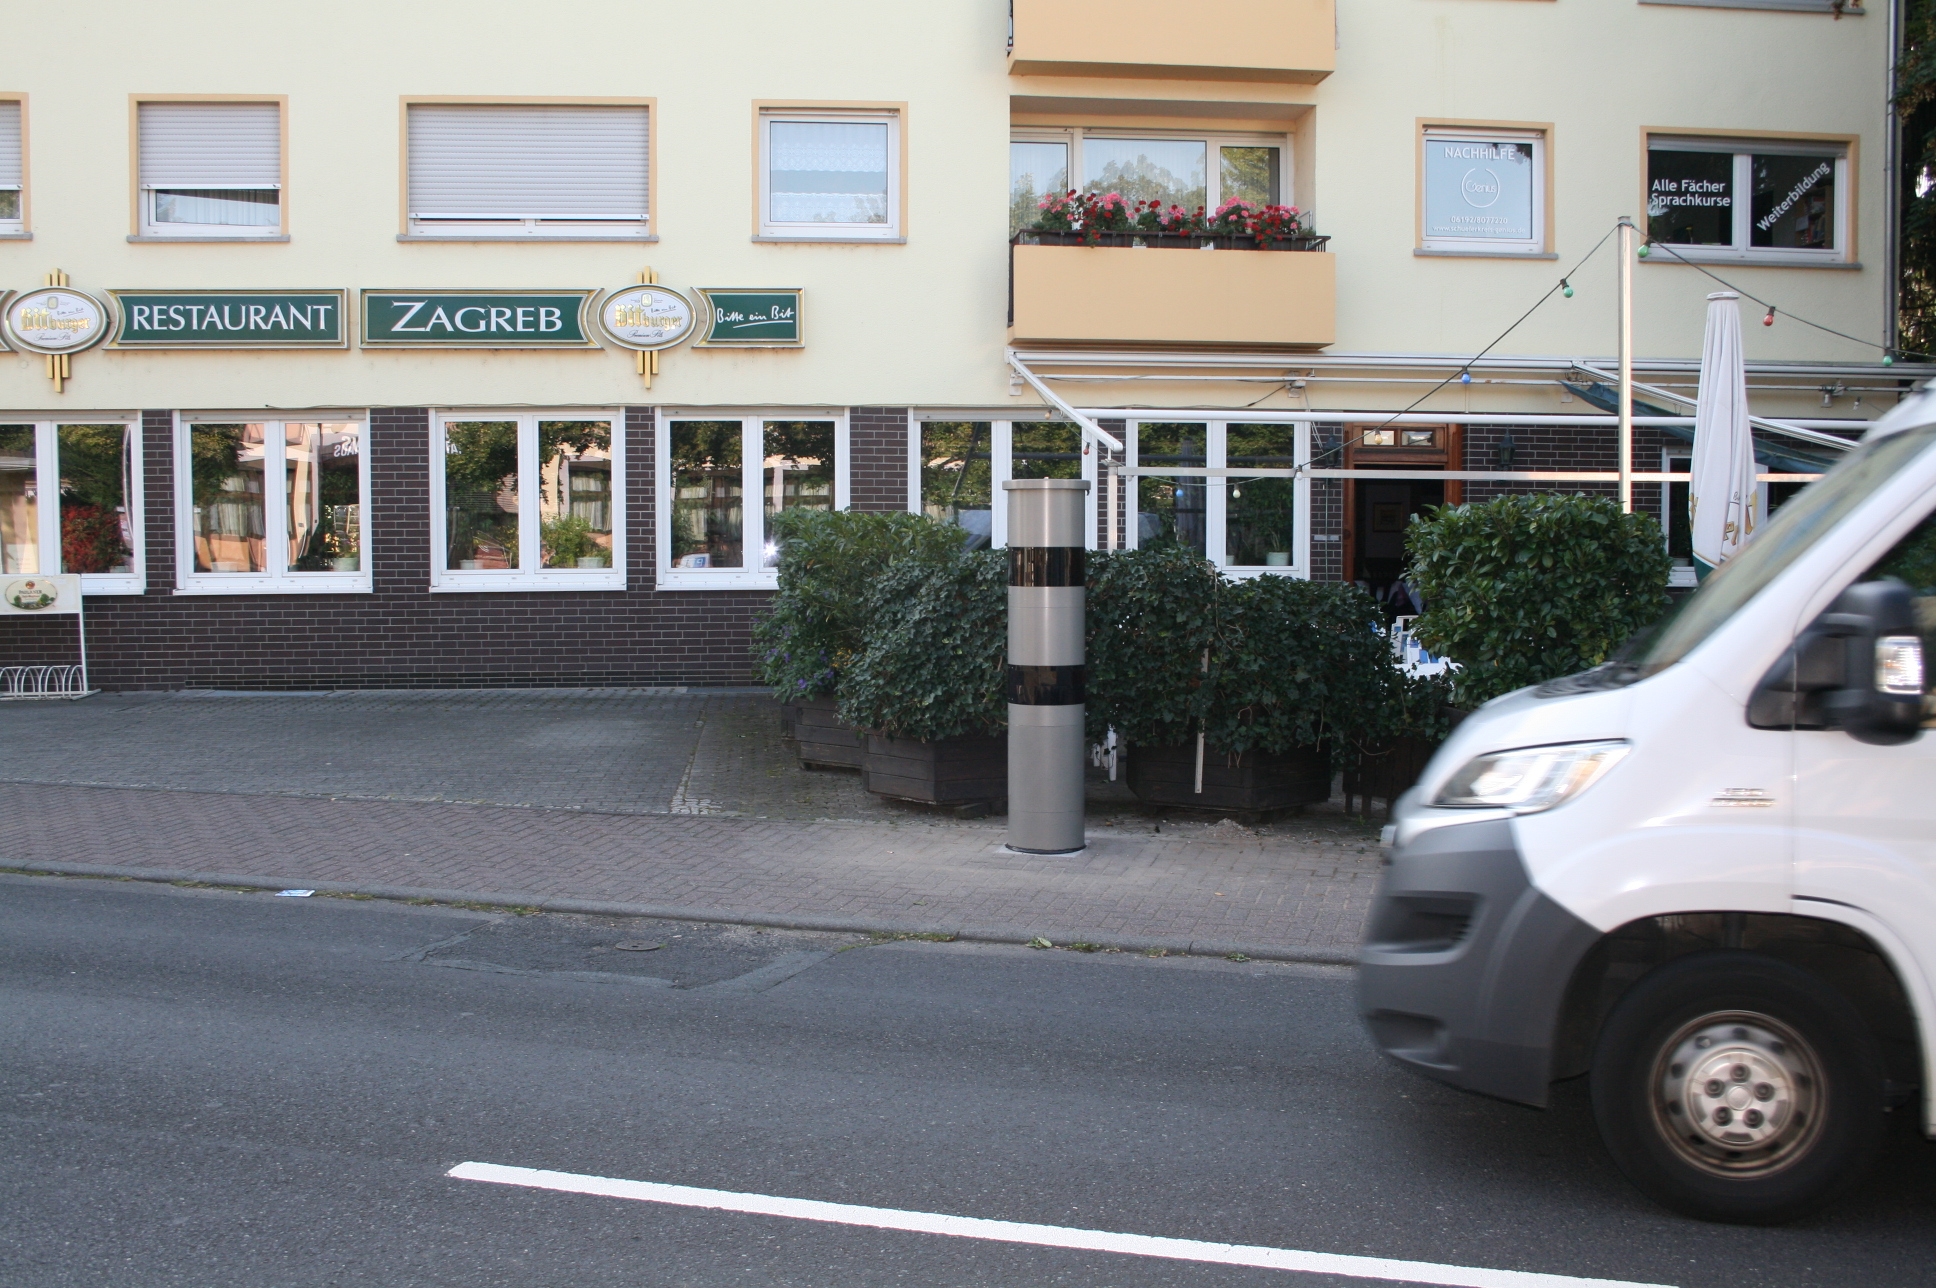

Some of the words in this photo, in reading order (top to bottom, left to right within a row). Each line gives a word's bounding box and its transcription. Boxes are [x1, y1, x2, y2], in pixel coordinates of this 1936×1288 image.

[1444, 146, 1515, 160] NACHHILFE
[1465, 180, 1497, 193] Genius
[1652, 178, 1677, 192] Alle
[1681, 179, 1725, 193] Fächer
[1651, 193, 1731, 208] Sprachkurse
[1756, 162, 1830, 232] Weiterbildung
[20, 307, 91, 334] Bitburger
[132, 302, 334, 333] RESTAURANT
[391, 299, 563, 334] ZAGREB
[613, 303, 683, 332] Bitburger
[716, 307, 744, 323] Bitte
[748, 312, 767, 321] ein
[771, 305, 794, 320] Bit
